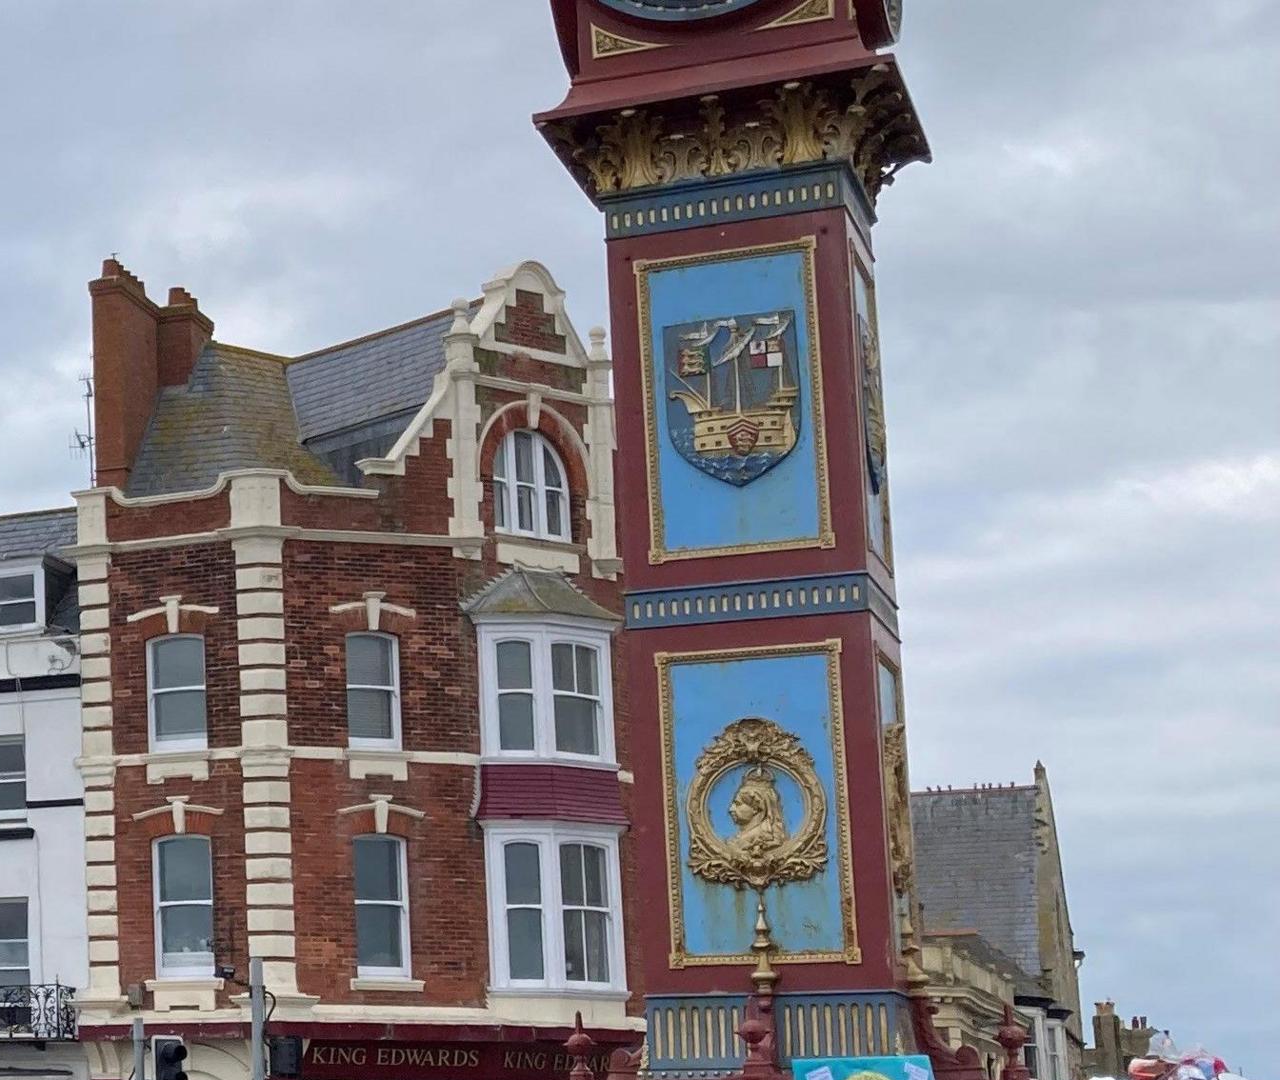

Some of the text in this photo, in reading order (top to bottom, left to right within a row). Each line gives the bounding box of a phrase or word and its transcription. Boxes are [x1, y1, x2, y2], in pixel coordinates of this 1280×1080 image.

[312, 1047, 479, 1067] KING EDWARDS
[504, 1051, 611, 1072] KING EDAR
